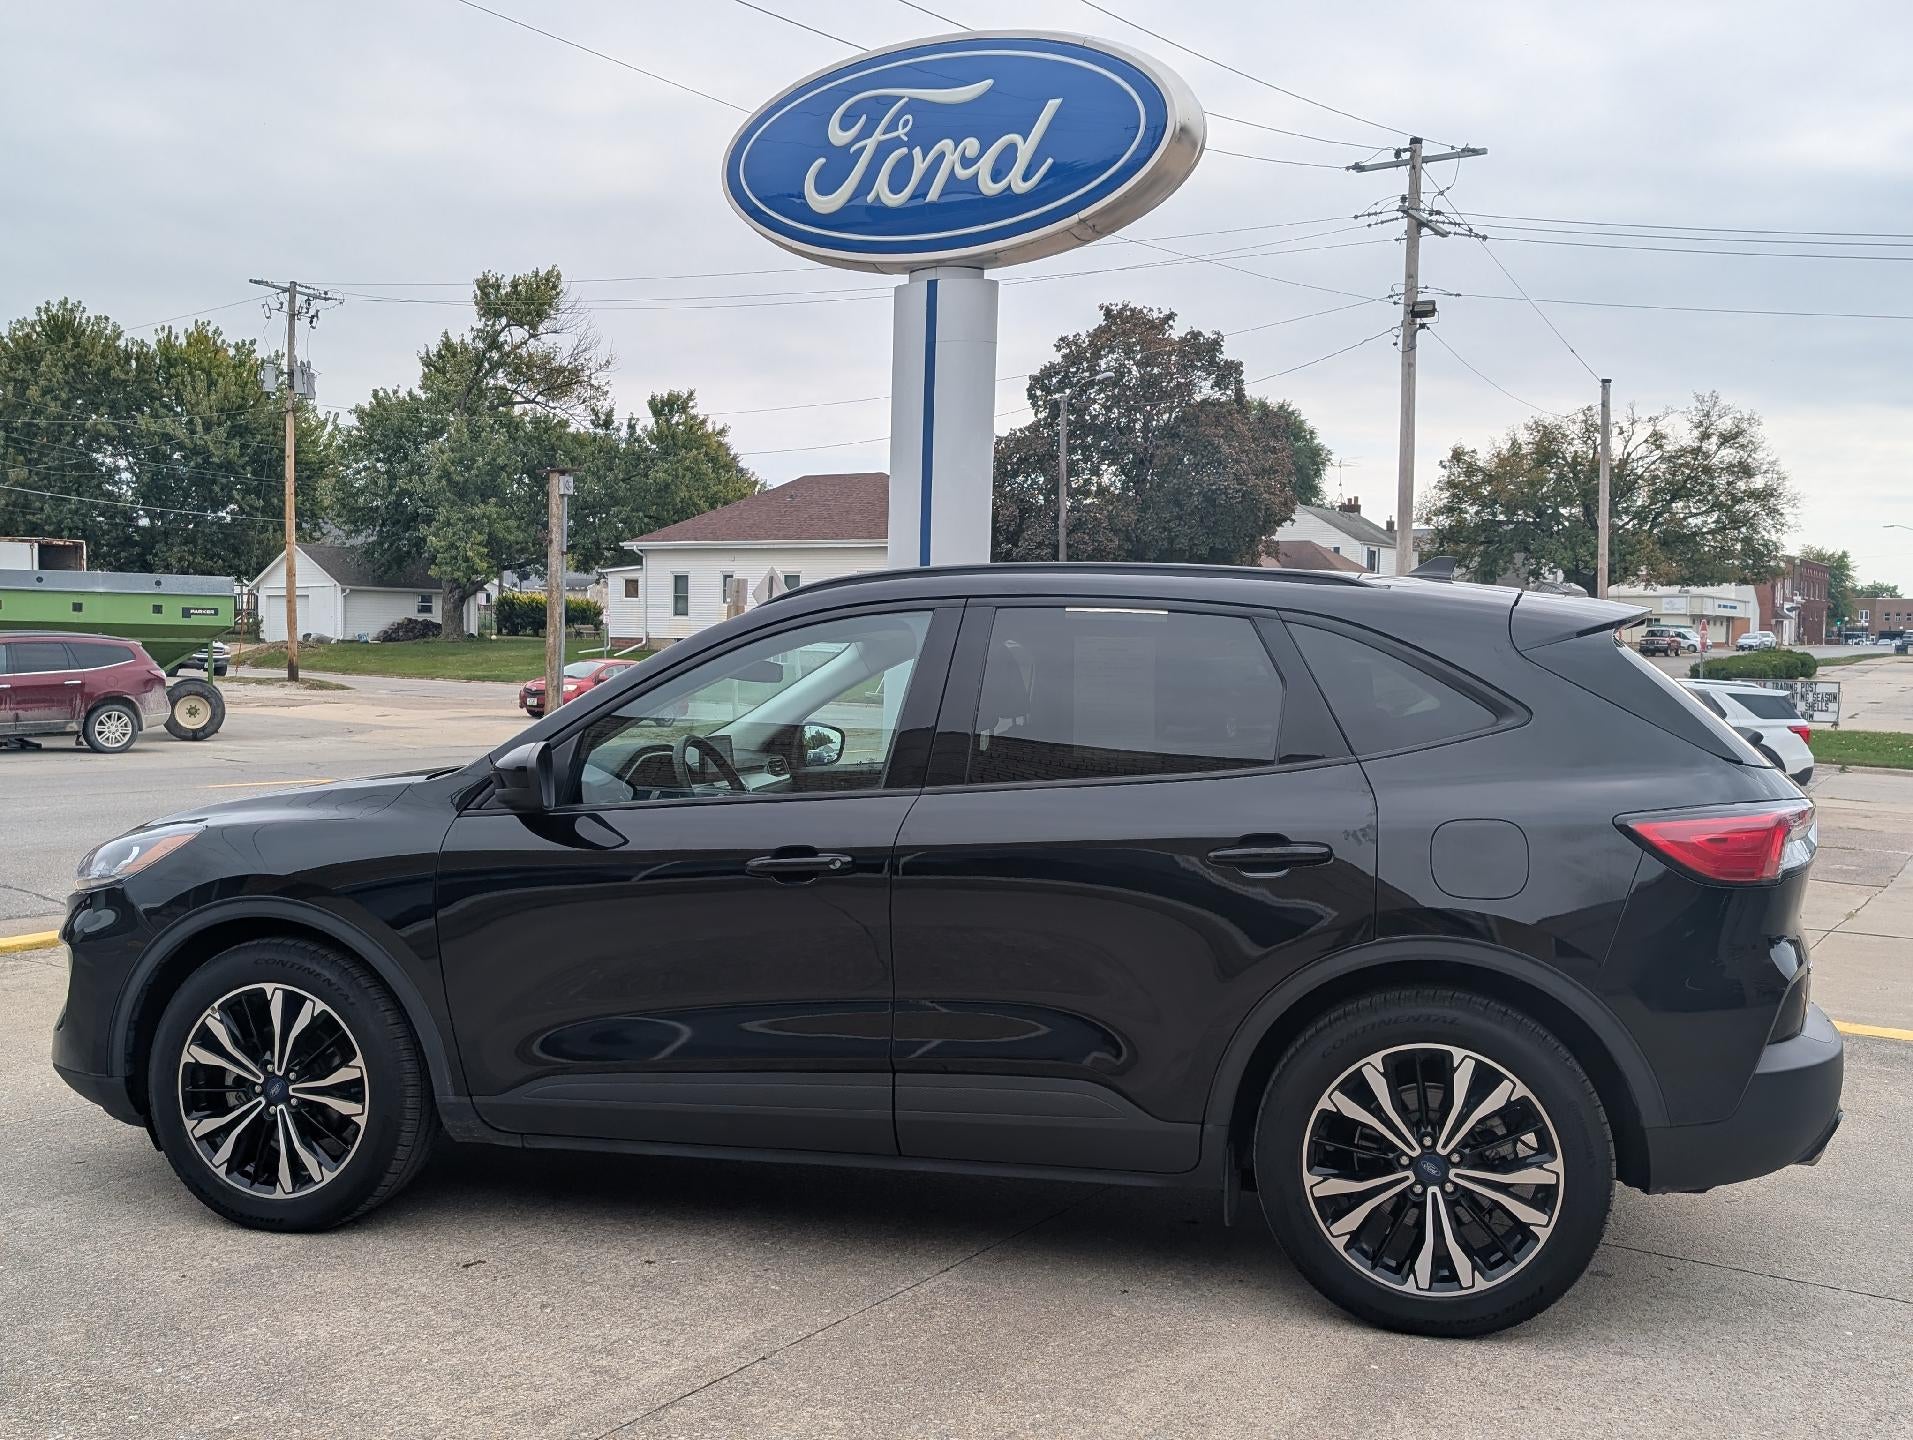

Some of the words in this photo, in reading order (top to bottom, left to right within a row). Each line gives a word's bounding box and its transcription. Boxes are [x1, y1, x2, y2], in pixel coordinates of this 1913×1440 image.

[805, 79, 1063, 214] Ford
[1772, 681, 1798, 693] TRADING
[1801, 682, 1818, 693] POST
[1812, 693, 1838, 704] SEASON
[1805, 702, 1829, 712] SHELLS
[1800, 711, 1815, 720] NOW
